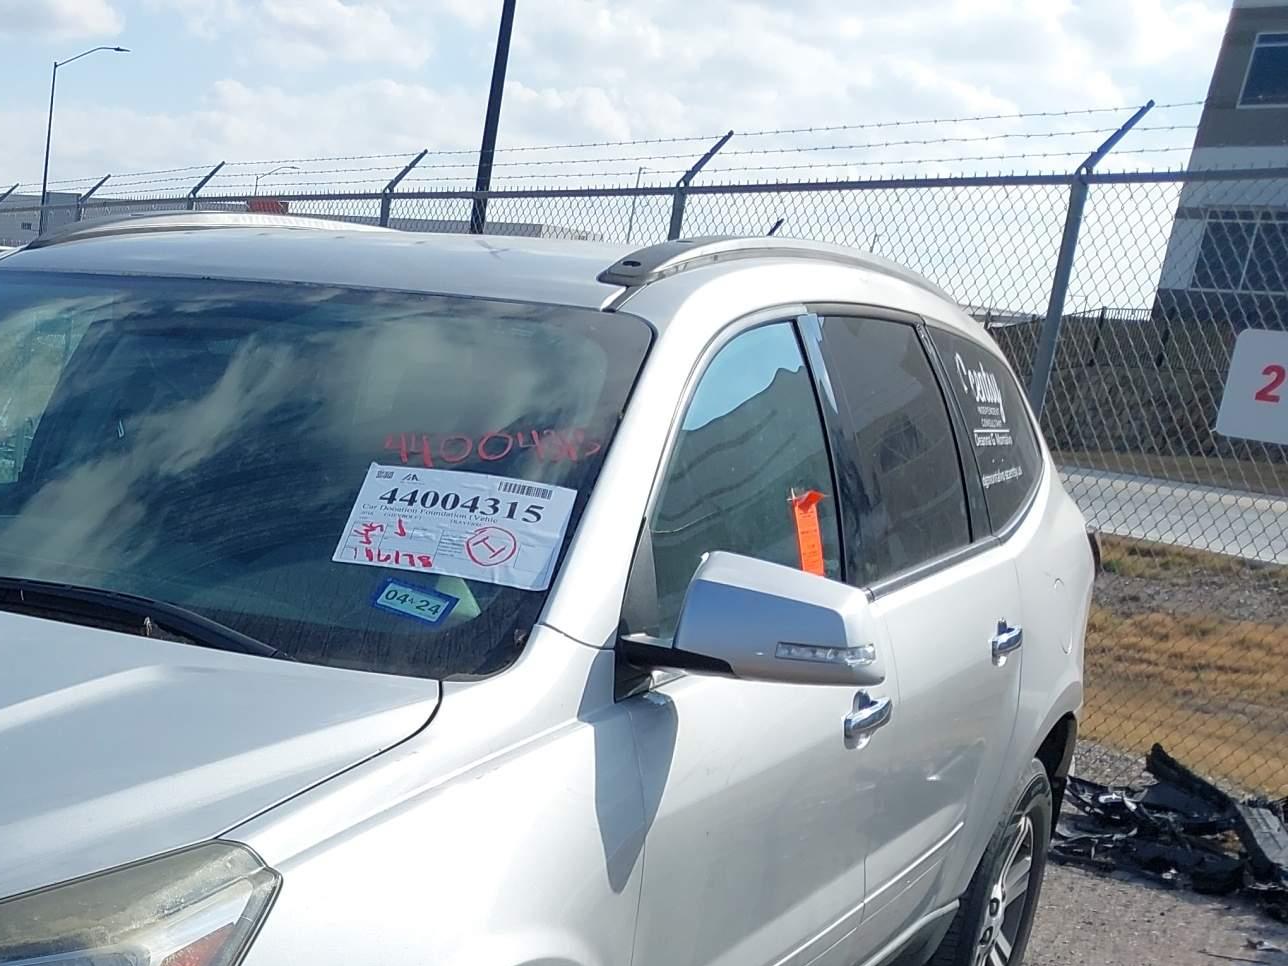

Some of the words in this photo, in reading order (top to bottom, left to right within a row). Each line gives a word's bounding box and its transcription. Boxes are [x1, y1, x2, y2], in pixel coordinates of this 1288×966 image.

[1254, 365, 1286, 403] 2
[379, 487, 545, 524] 44004315
[419, 508, 467, 519] Foundation
